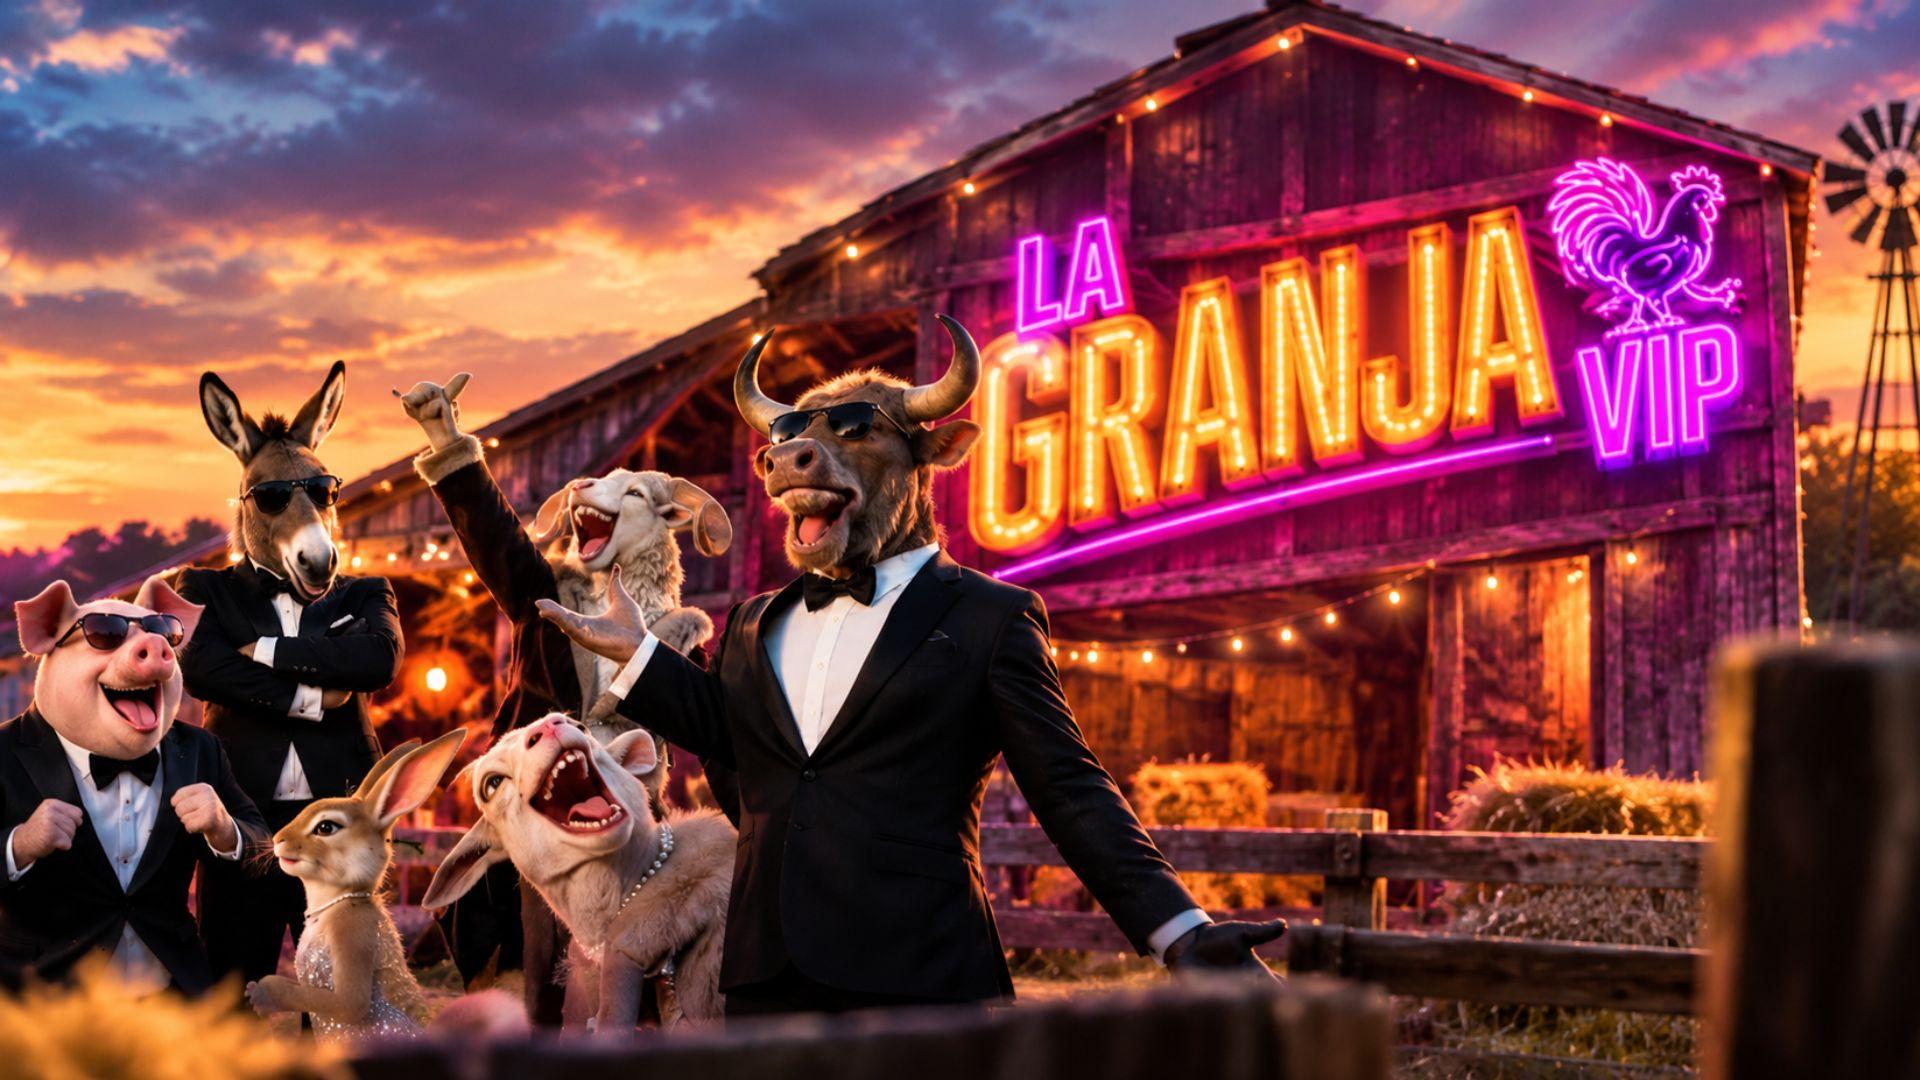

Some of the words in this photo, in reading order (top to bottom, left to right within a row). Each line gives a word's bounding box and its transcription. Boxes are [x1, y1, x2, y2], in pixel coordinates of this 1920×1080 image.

[1017, 217, 1126, 334] LA
[969, 207, 1561, 552] GRANJA
[1577, 324, 1741, 464] VIP
